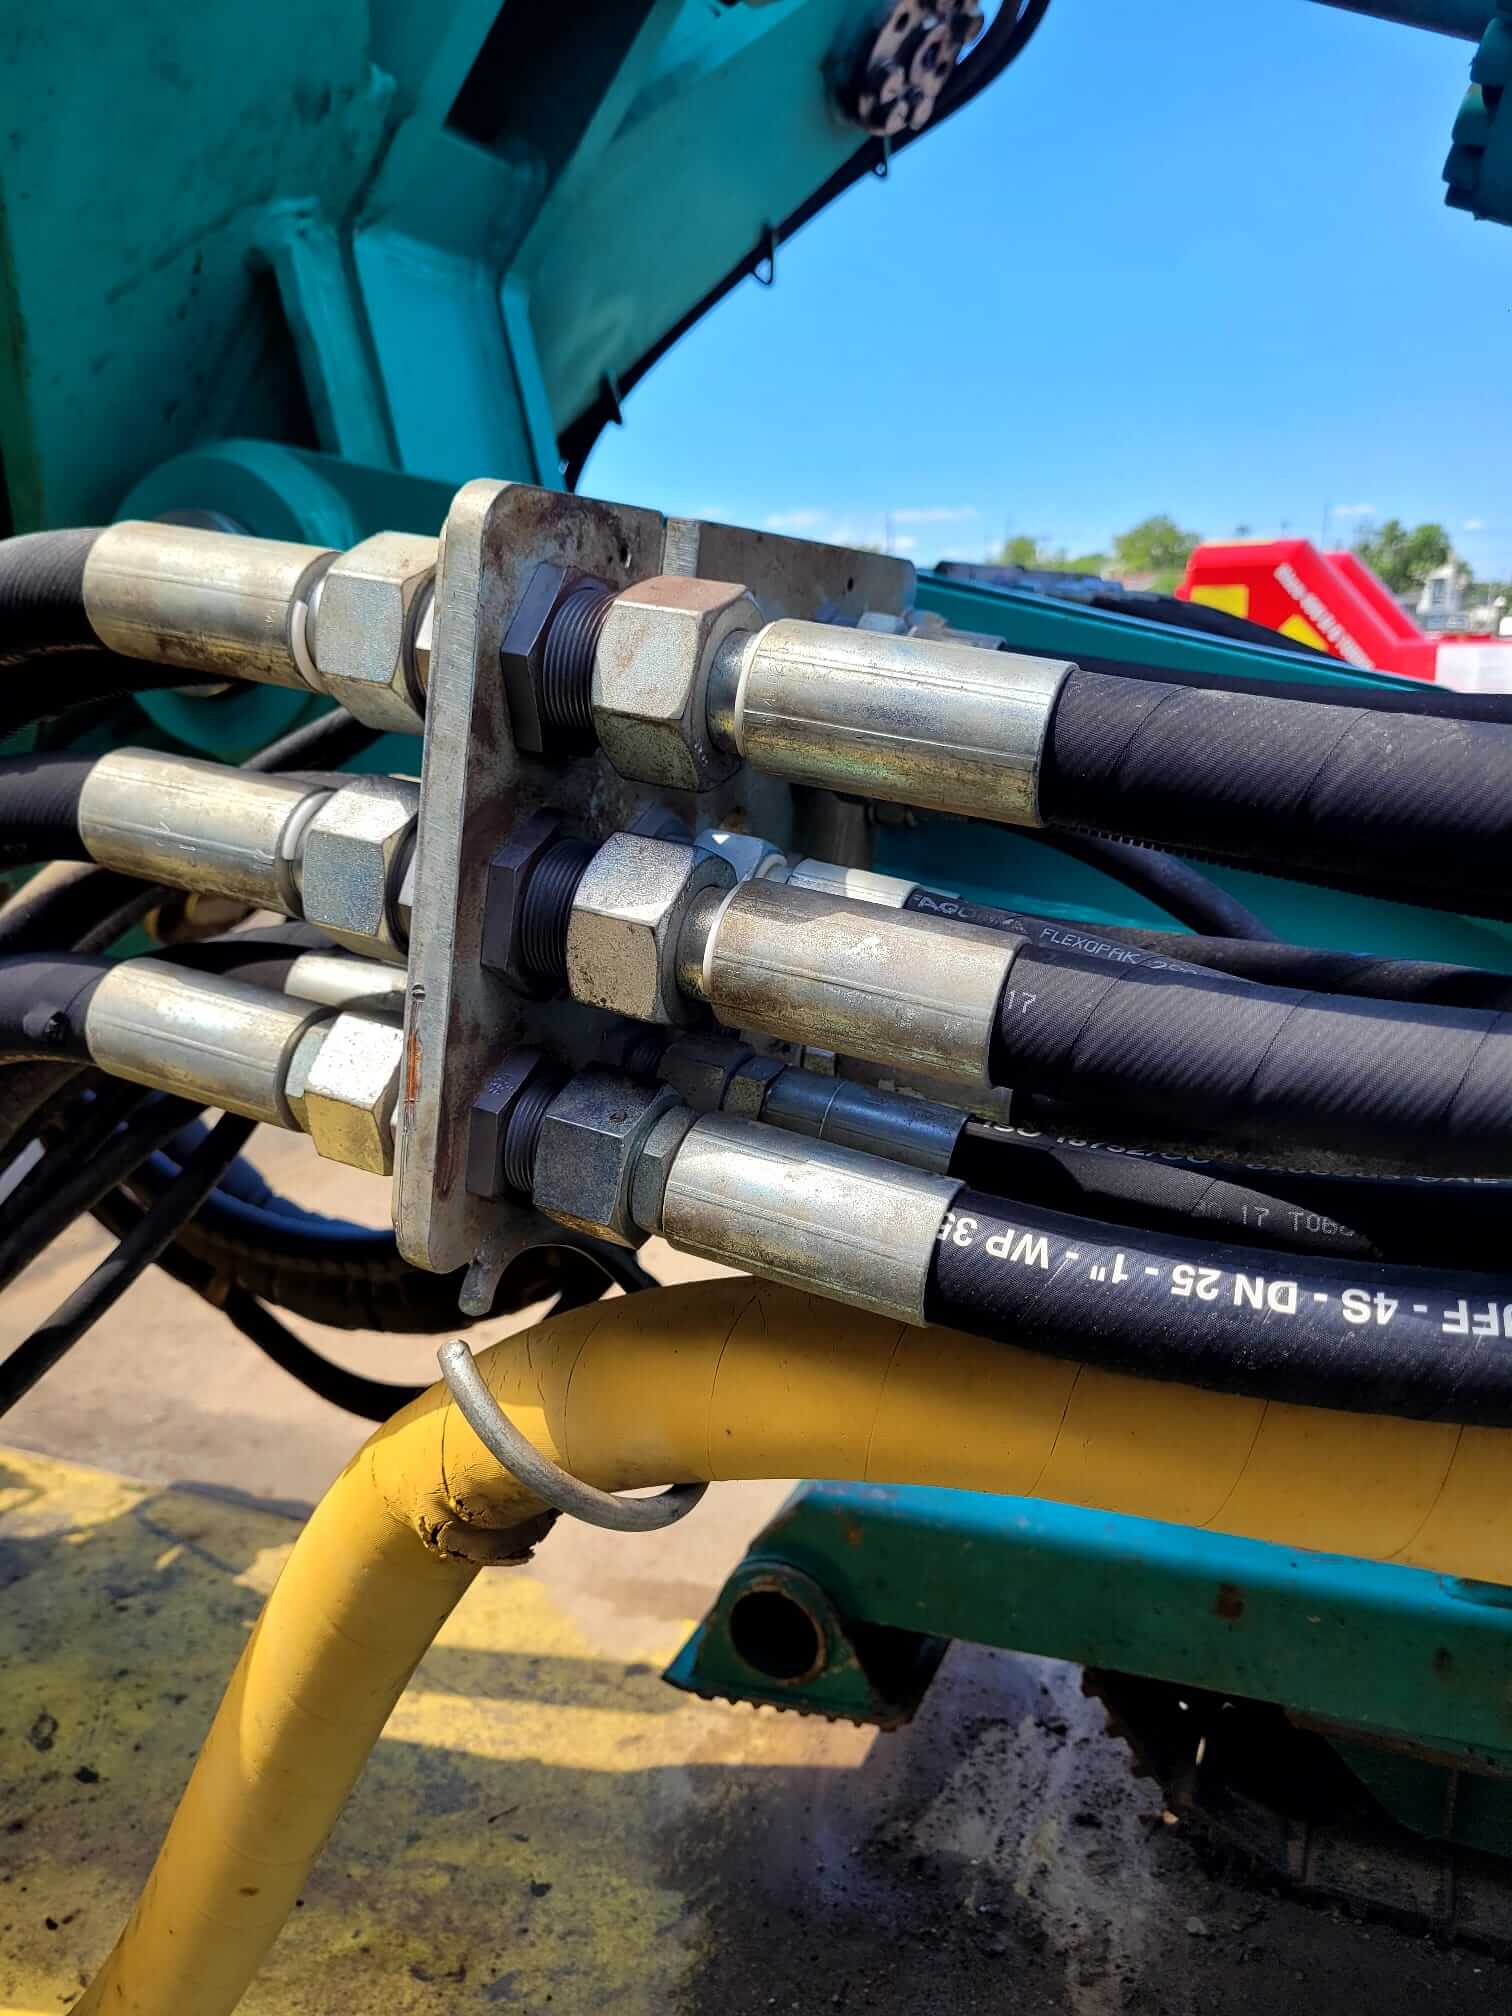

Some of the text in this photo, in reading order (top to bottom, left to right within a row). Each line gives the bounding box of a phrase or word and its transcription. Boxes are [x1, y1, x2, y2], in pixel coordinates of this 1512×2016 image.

[1039, 928, 1141, 966] FLEXOPAK
[1006, 990, 1037, 1014] 17
[985, 1229, 1049, 1269] WP
[1089, 1253, 1129, 1284] 1"
[1171, 1264, 1221, 1301] 25
[1233, 1273, 1299, 1314] DN
[1341, 1288, 1399, 1325] 4S
